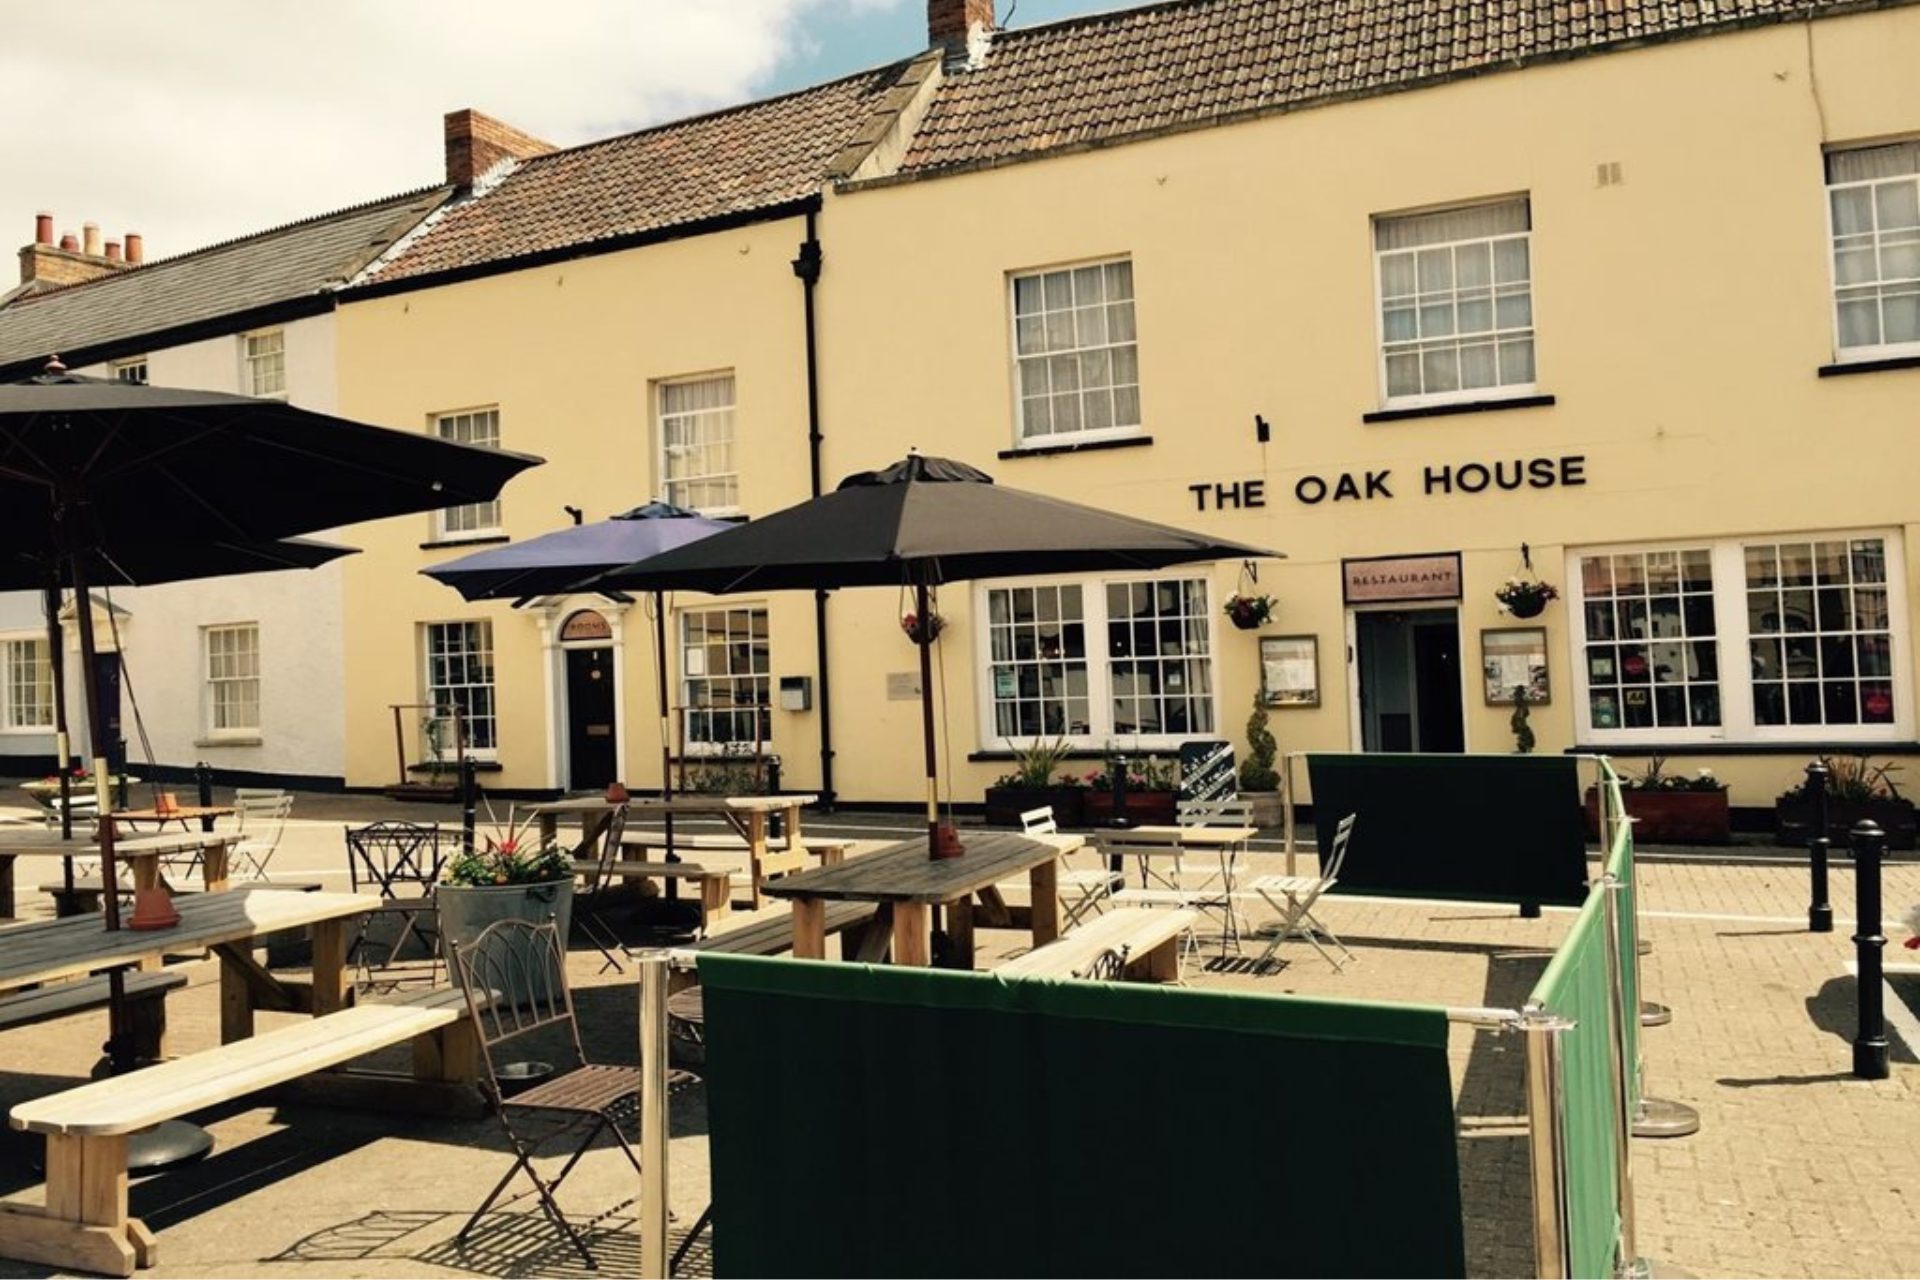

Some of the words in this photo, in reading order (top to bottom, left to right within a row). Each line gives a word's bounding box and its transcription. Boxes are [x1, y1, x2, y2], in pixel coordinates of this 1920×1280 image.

[1189, 481, 1265, 511] THE
[1295, 470, 1393, 504] OAK
[1424, 456, 1587, 496] HOUSE
[1352, 572, 1452, 587] RESTAURANT
